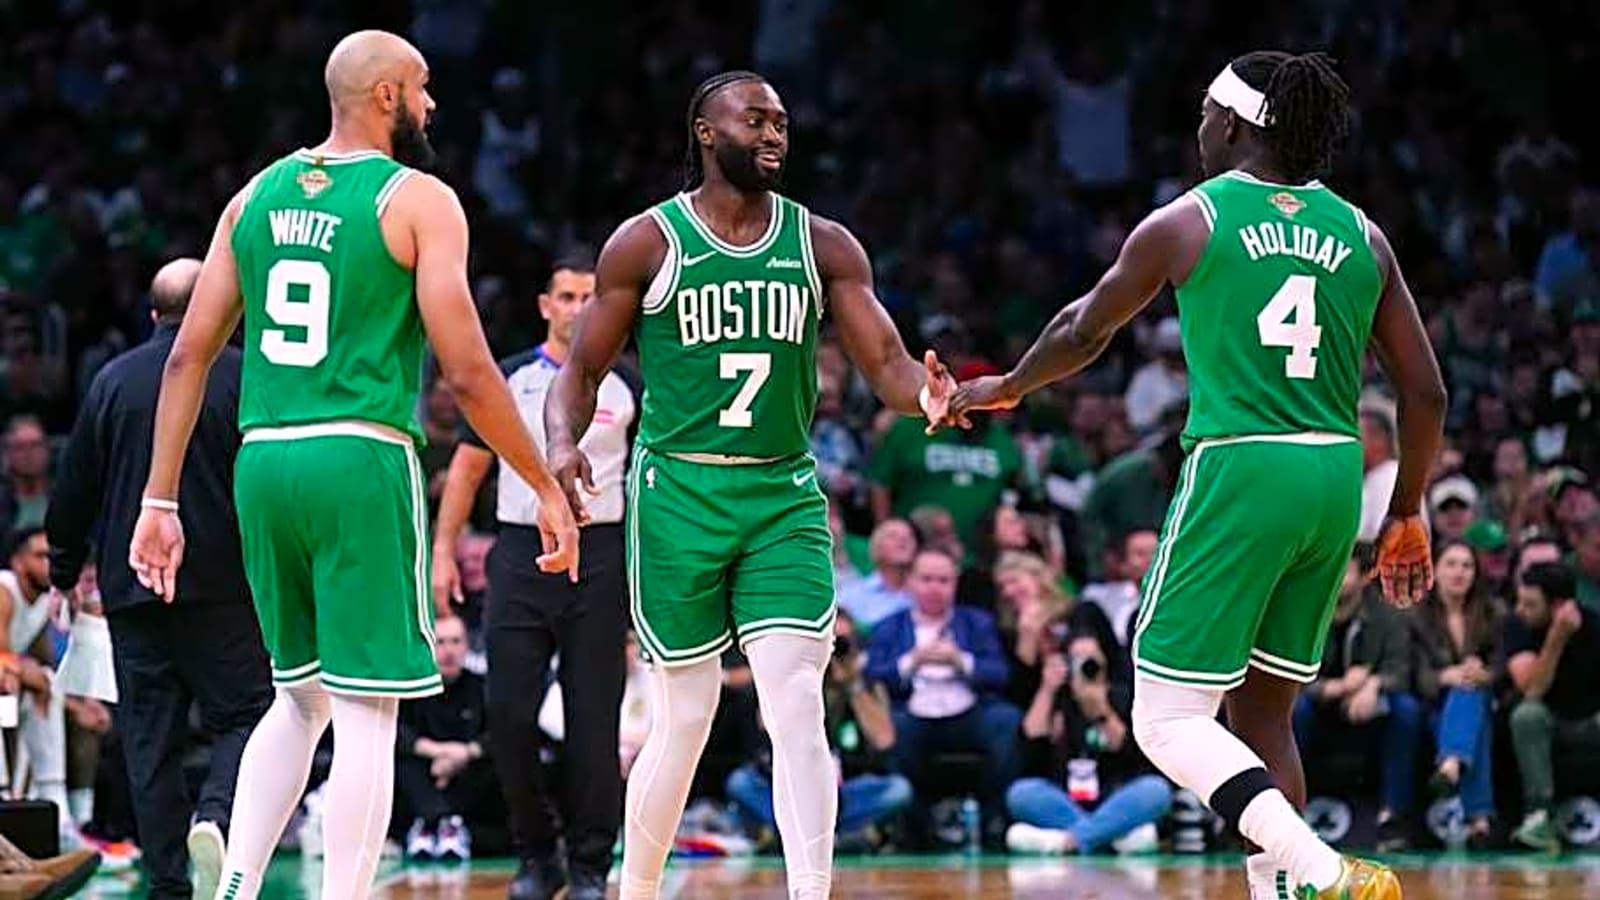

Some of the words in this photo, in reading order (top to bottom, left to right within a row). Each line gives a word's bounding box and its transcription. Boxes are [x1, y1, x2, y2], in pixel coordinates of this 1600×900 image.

[268, 208, 343, 253] WHITE
[1238, 221, 1353, 273] HOLIDAY
[259, 259, 331, 368] 9
[677, 280, 809, 347] BOSTON
[1257, 274, 1322, 379] 4
[718, 353, 772, 428] 7
